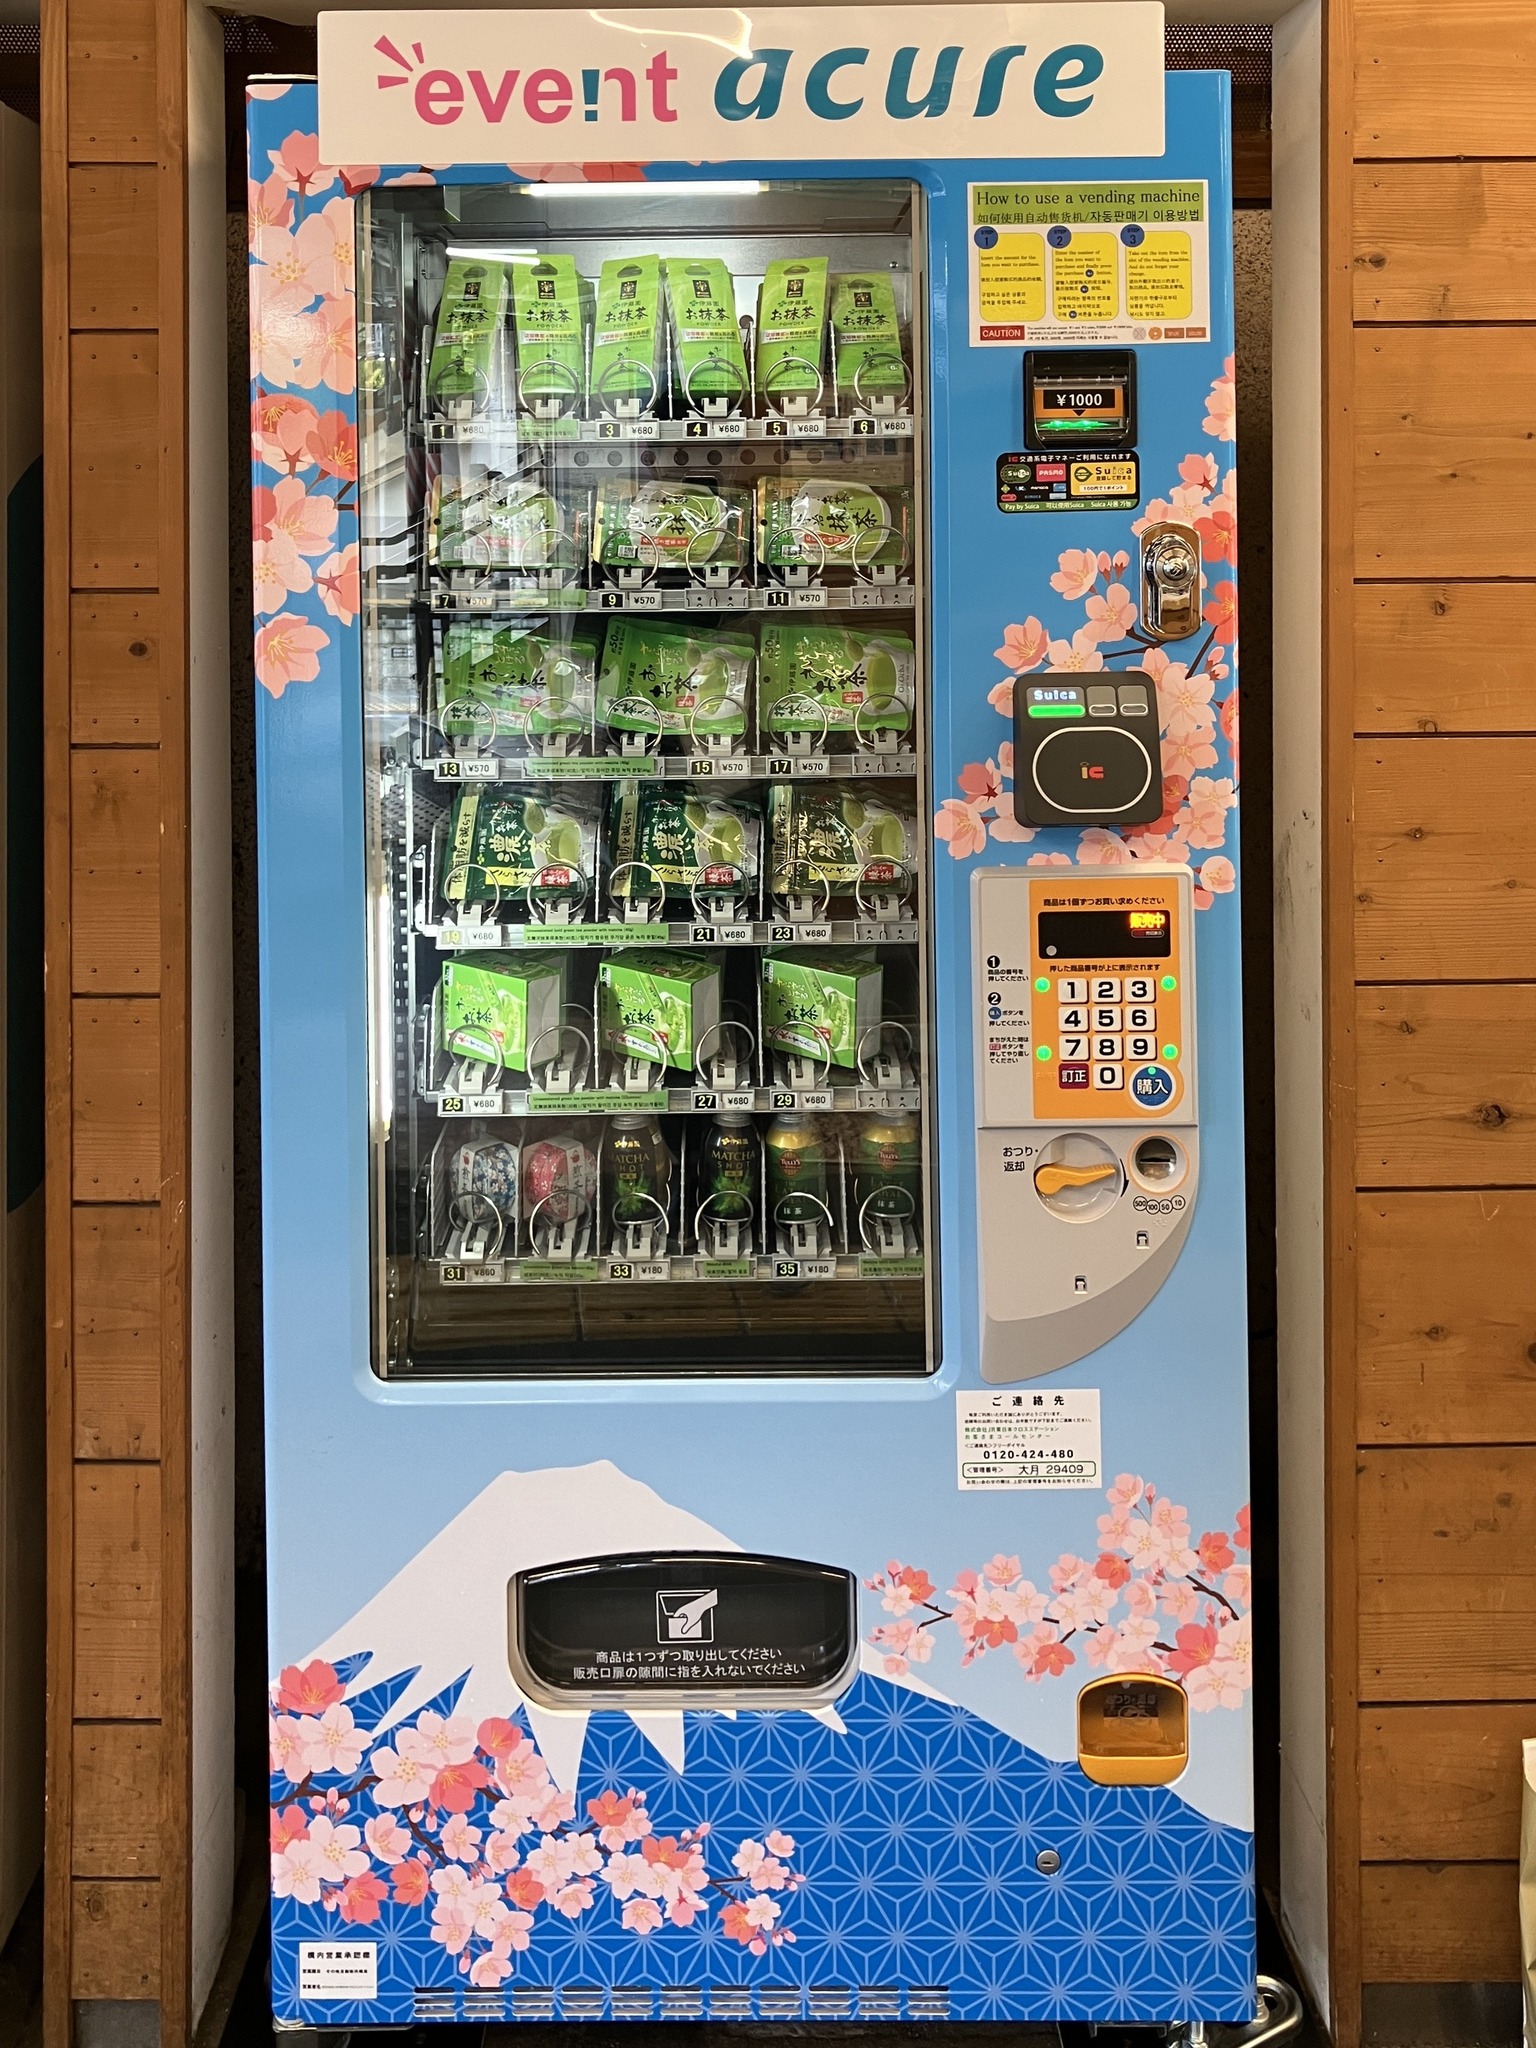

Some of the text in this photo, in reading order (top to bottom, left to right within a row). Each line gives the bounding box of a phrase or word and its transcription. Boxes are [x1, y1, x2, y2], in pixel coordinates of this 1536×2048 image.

[713, 44, 1105, 121] acure
[977, 189, 1201, 206] How to use a vending machine
[1153, 209, 1200, 222] 이용방법
[1056, 235, 1064, 246] 2
[1129, 234, 1137, 245] 3
[526, 308, 573, 322] お抹茶
[604, 306, 649, 323] お抹茶
[686, 307, 730, 321] お抹茶
[770, 306, 816, 321] お抹茶
[843, 314, 890, 326] お抹茶
[982, 329, 1021, 338] CAUTION
[1056, 394, 1102, 406] ¥1000
[438, 426, 446, 437] 1
[605, 424, 653, 437] 3 ¥680
[692, 423, 740, 436] 4 ¥680
[772, 422, 819, 435] 5 ¥680
[860, 421, 906, 433] 6 ¥680
[1095, 466, 1132, 475] Suica
[441, 595, 449, 607] 7
[608, 594, 655, 606] 9 ¥570
[771, 593, 821, 606] 11 ¥570
[1033, 689, 1077, 701] Suica
[442, 762, 490, 774] 13 ¥570
[695, 762, 743, 773] 15 ¥570
[774, 761, 824, 773] 17 ¥570
[445, 931, 494, 944] 19 ¥680
[697, 928, 746, 940] 21 ¥680
[775, 928, 827, 939] 23 ¥680
[1066, 981, 1076, 999] 1
[1098, 981, 1115, 998] 2
[1131, 980, 1148, 998] 3
[1064, 1010, 1081, 1027] 4
[1098, 1009, 1115, 1027] 5
[1131, 1009, 1148, 1026] 6
[1065, 1039, 1082, 1056] 7
[1099, 1039, 1116, 1056] 8
[1132, 1038, 1149, 1056] 9
[1061, 1069, 1087, 1083] 訂正
[1100, 1067, 1116, 1085] 0
[1136, 1078, 1169, 1096] 購入
[445, 1098, 495, 1111] 25 ¥680
[698, 1095, 749, 1108] 27 ¥680
[776, 1094, 826, 1107] 29 ¥680
[711, 1150, 756, 1160] MATCHA
[1003, 1161, 1026, 1172] 返却
[1134, 1200, 1146, 1208] 500
[1161, 1203, 1170, 1211] 50
[446, 1267, 461, 1279] 31
[613, 1265, 663, 1277] 33 ¥180
[779, 1263, 829, 1276] 35 ¥180
[983, 1449, 1074, 1460] 0120-424-480
[1018, 1464, 1039, 1476] 大月
[1046, 1464, 1084, 1475] 29409
[596, 1648, 782, 1664] 商品は1つずつ取り出してください
[573, 1663, 806, 1680] 販売口扉の隙間に指を入れないでください
